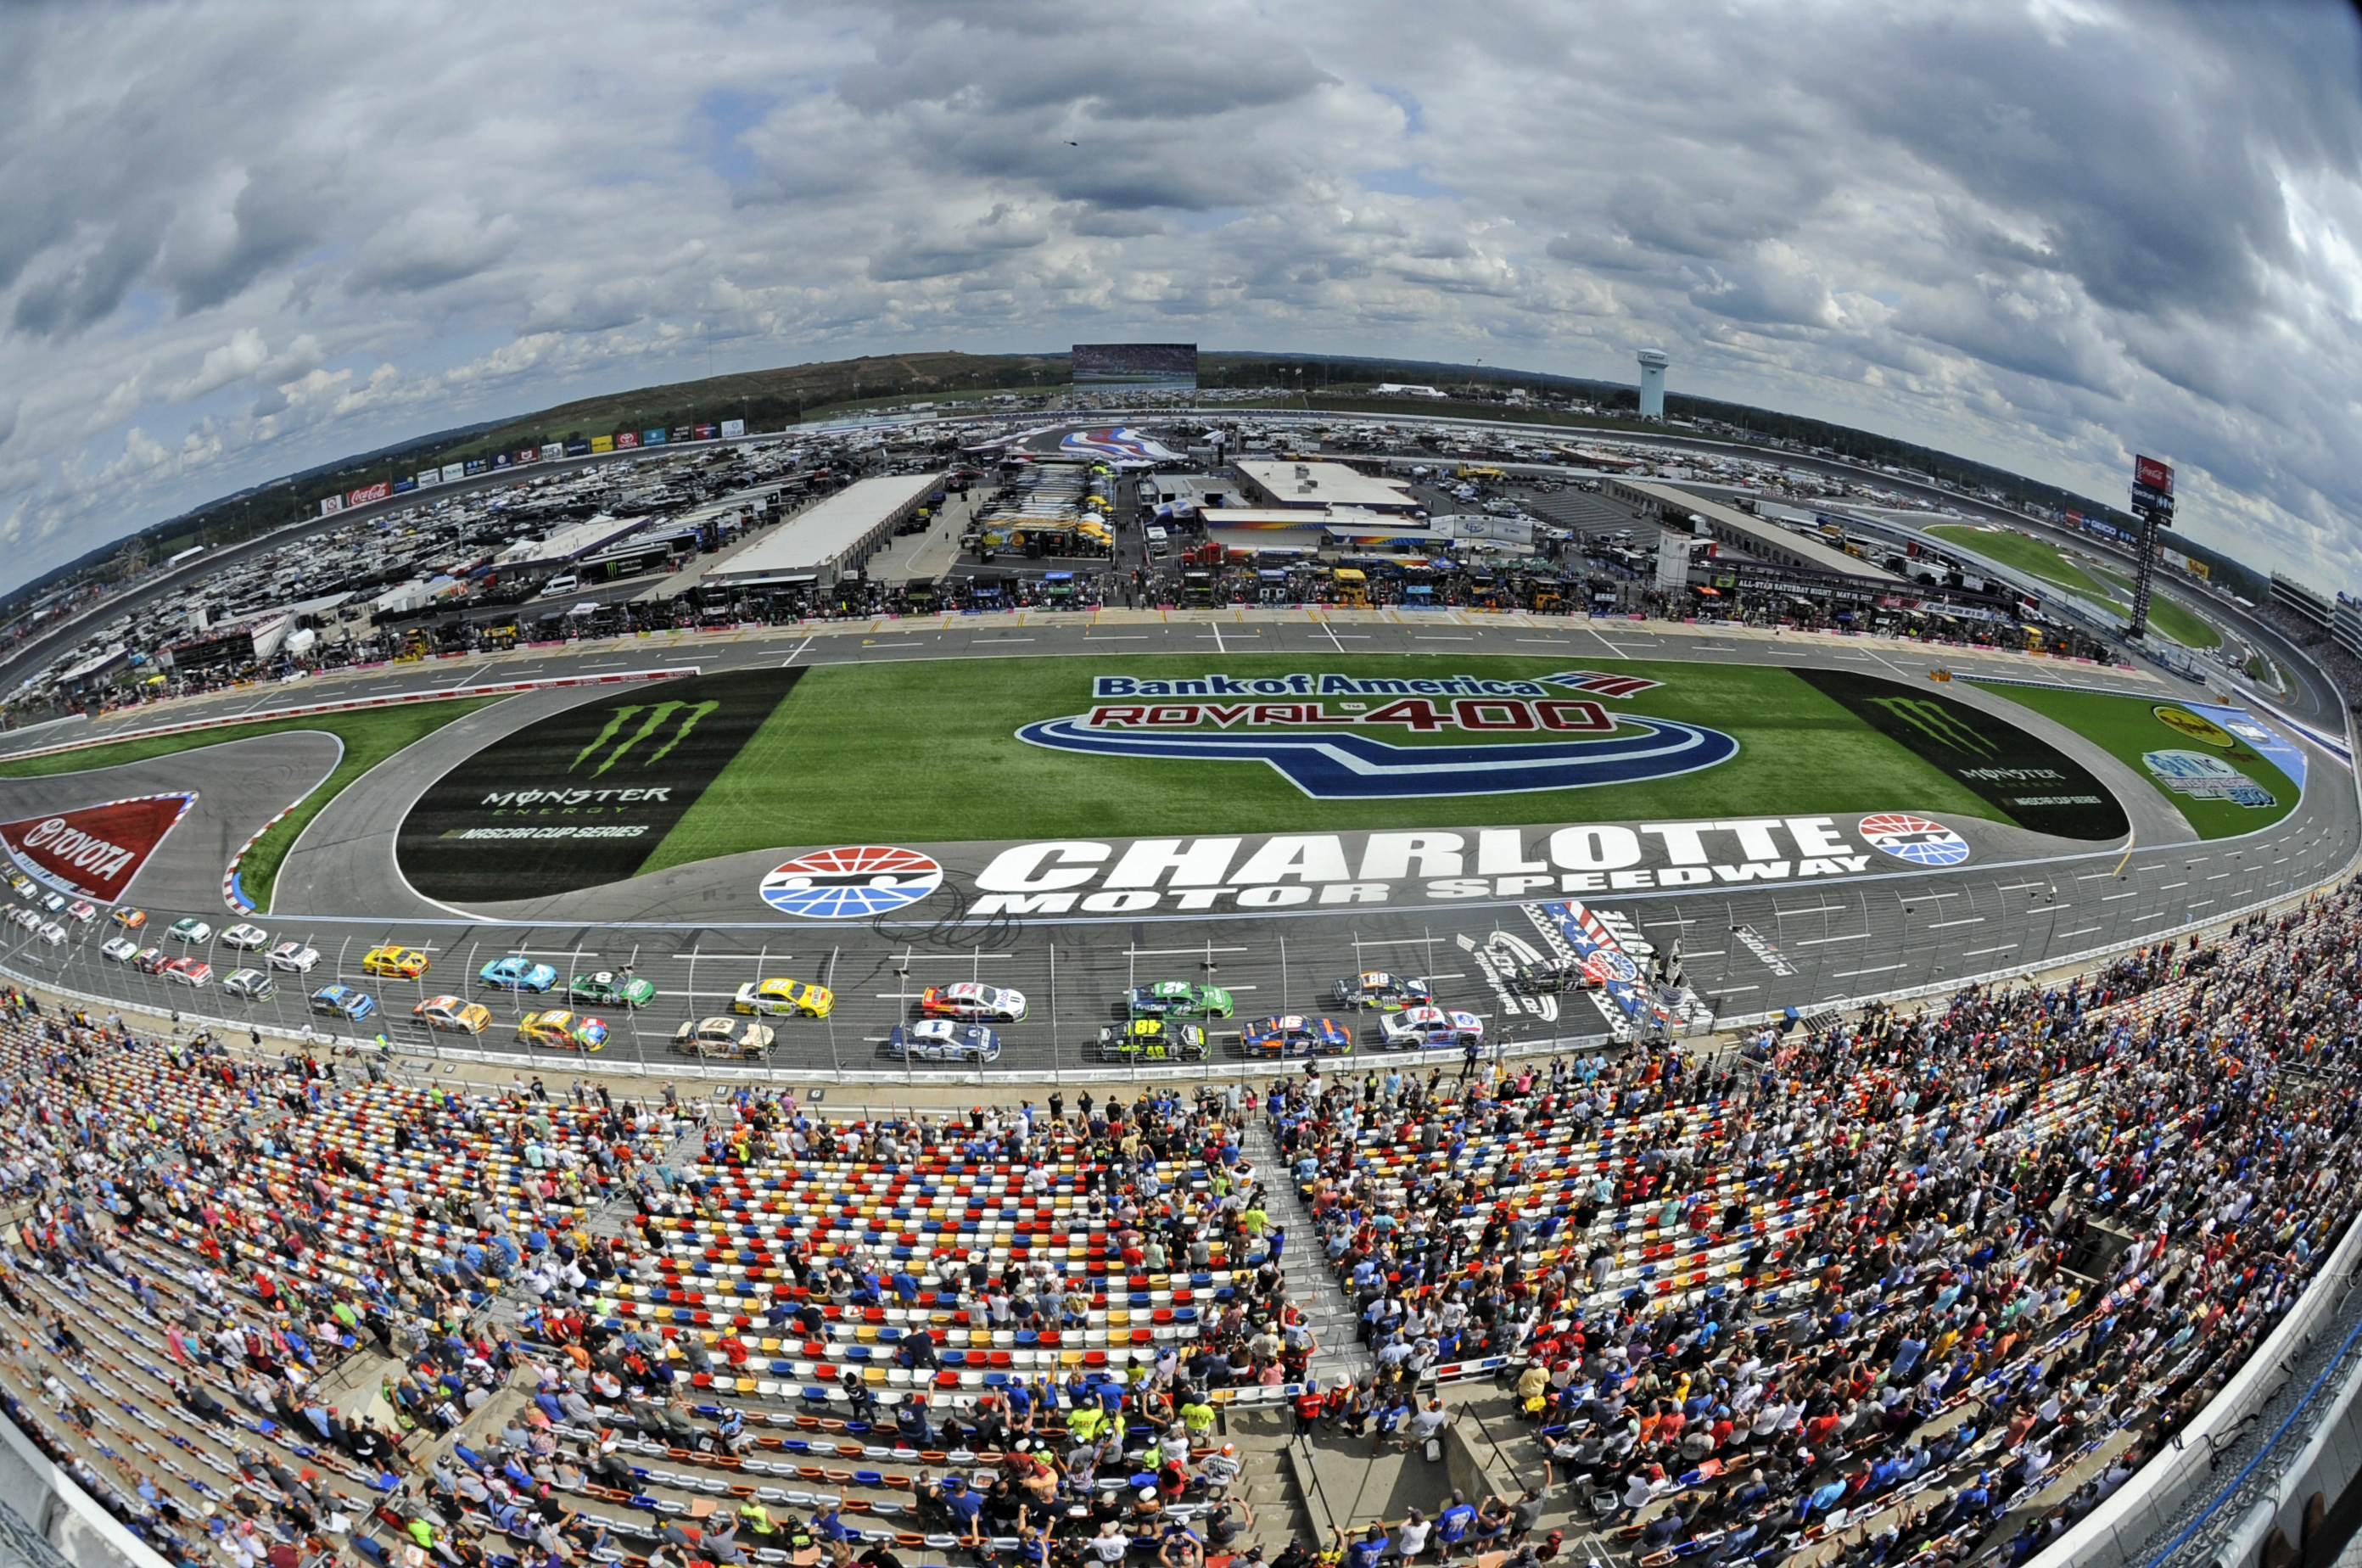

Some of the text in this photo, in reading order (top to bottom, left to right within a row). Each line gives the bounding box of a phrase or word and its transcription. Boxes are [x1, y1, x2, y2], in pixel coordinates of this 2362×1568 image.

[2091, 519, 2117, 535] GEICO
[1738, 580, 1773, 591] ALL-STAR
[1774, 582, 1809, 595] SATURDAY
[1810, 587, 1832, 596] NIGHT
[1093, 673, 1550, 698] Bank of America
[1088, 703, 1357, 728] ROVAL
[1361, 698, 1618, 732] 400
[1958, 767, 2067, 781] MONSTER
[480, 787, 672, 806] MONSTER
[2013, 795, 2102, 806] NASCAR CUP SERIES
[492, 806, 629, 815] ENERGY
[458, 826, 649, 839] NASCAR CUP SERIES
[45, 827, 135, 882] TOYOTA
[975, 816, 1855, 892] CHARLOTTE
[966, 854, 1872, 915] MOTOR SPEEDWAY
[1473, 951, 1502, 984] America
[595, 971, 613, 983] 8
[1369, 972, 1389, 984] 88
[1161, 982, 1188, 994] 42
[1564, 981, 1580, 991] 41
[1173, 1005, 1192, 1016] 42
[1496, 992, 1522, 1015] Bank
[1134, 1019, 1161, 1035] 48
[1146, 1045, 1167, 1059] 48
